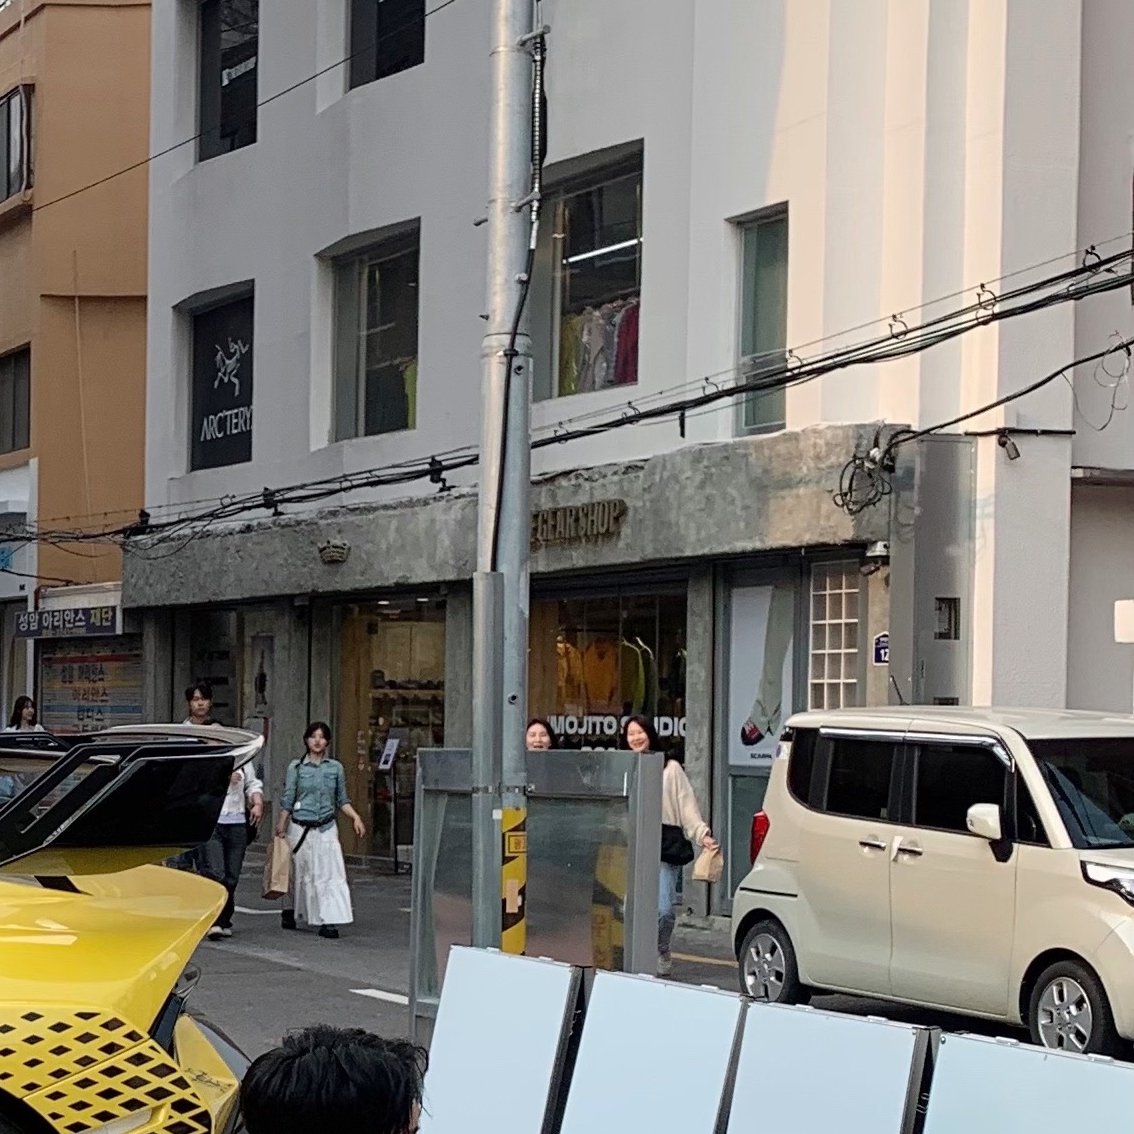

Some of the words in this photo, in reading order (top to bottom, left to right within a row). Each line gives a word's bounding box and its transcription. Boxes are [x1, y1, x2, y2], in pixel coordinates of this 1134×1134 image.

[200, 405, 253, 441] ARC'TERY
[578, 500, 626, 536] SHOP
[18, 611, 40, 631] 성암
[42, 609, 86, 630] 아리안스
[89, 607, 113, 627] 재단
[549, 716, 618, 735] MOJITO
